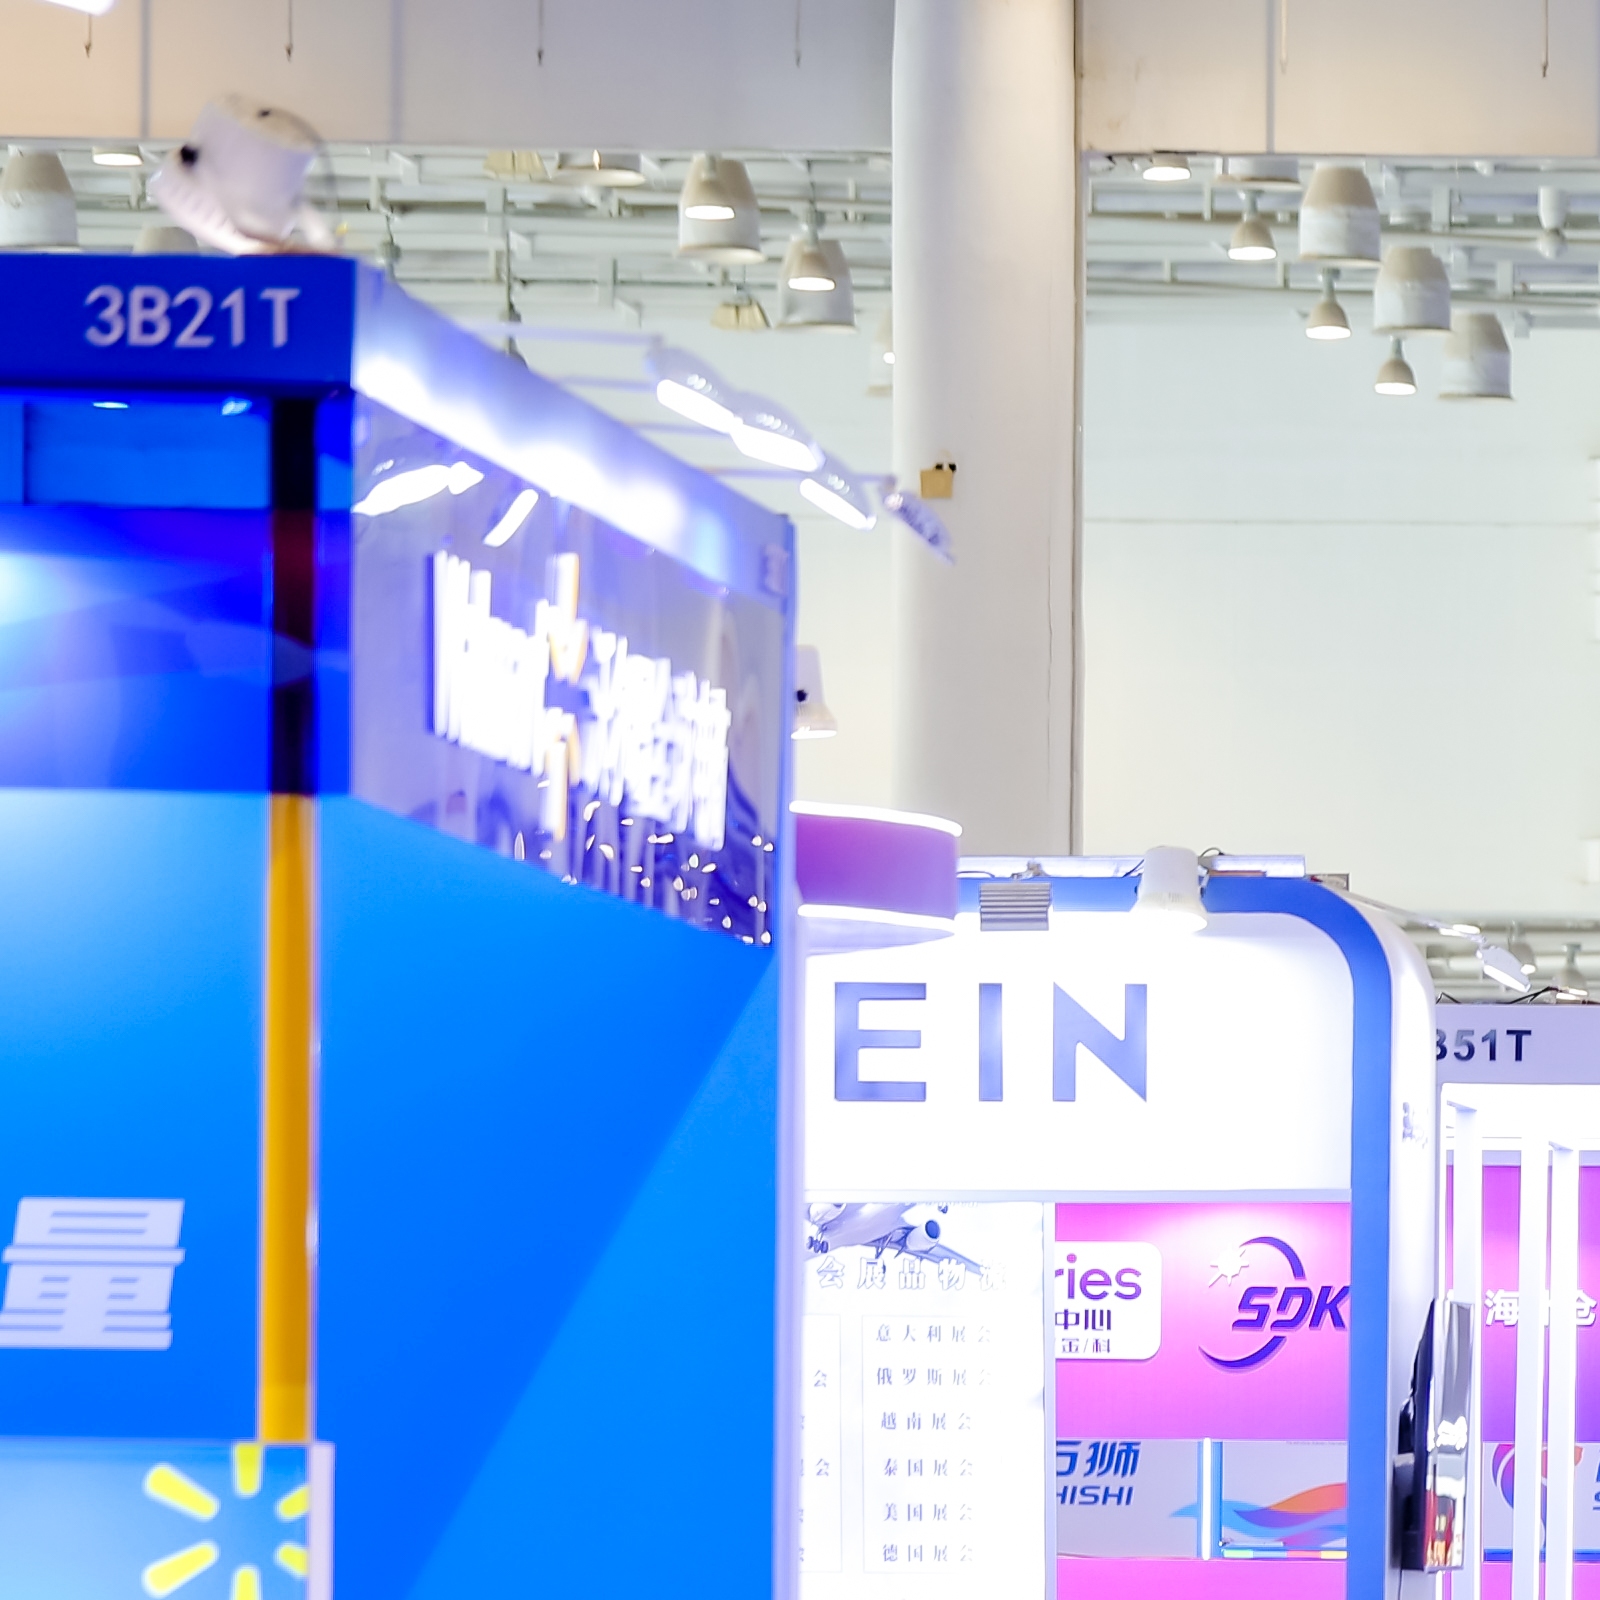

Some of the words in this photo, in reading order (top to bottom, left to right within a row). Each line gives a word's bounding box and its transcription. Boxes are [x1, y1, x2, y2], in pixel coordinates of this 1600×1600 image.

[83, 286, 302, 349] 3B21T
[834, 982, 1148, 1103] EIN
[0, 1197, 185, 1350] 量
[1232, 1285, 1351, 1332] SDK
